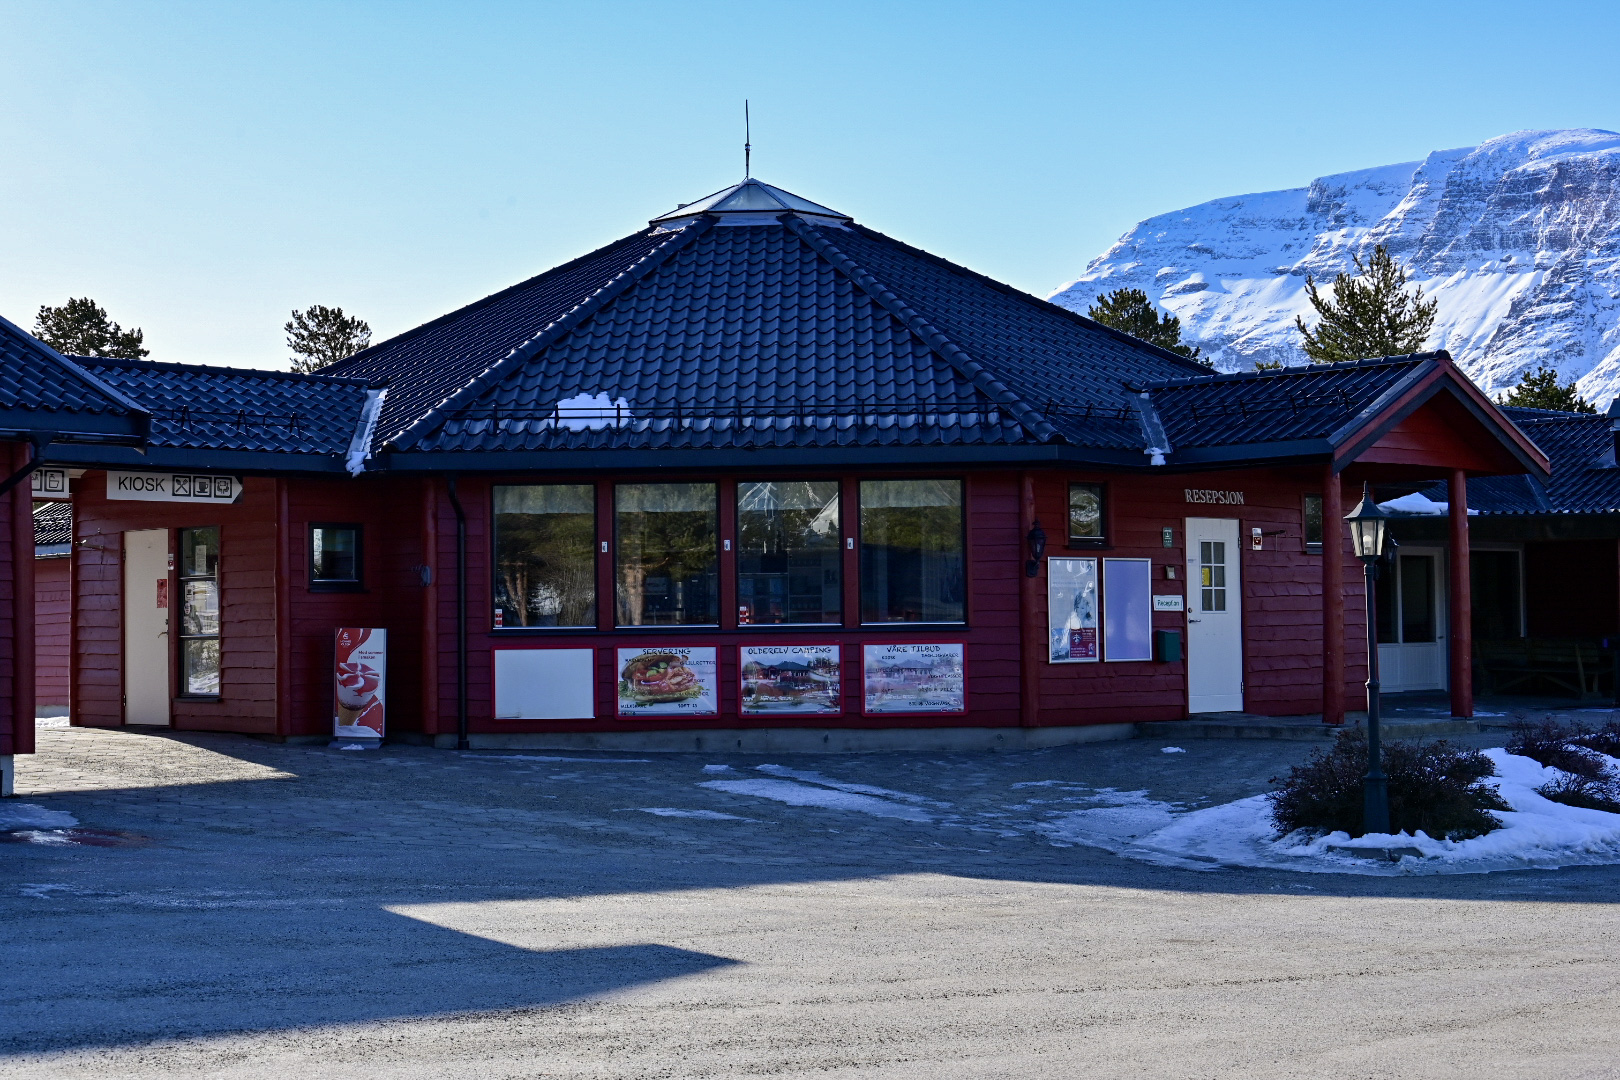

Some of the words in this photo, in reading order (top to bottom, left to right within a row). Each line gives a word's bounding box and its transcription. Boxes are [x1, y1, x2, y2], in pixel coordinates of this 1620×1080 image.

[118, 476, 165, 492] KIOSK
[1184, 488, 1245, 505] RESEPSJON
[1157, 599, 1180, 607] Reception
[748, 646, 789, 654] OLDERELV
[791, 646, 832, 654] CAMPING
[886, 644, 908, 653] VÅRE
[911, 644, 941, 653] TILBUD
